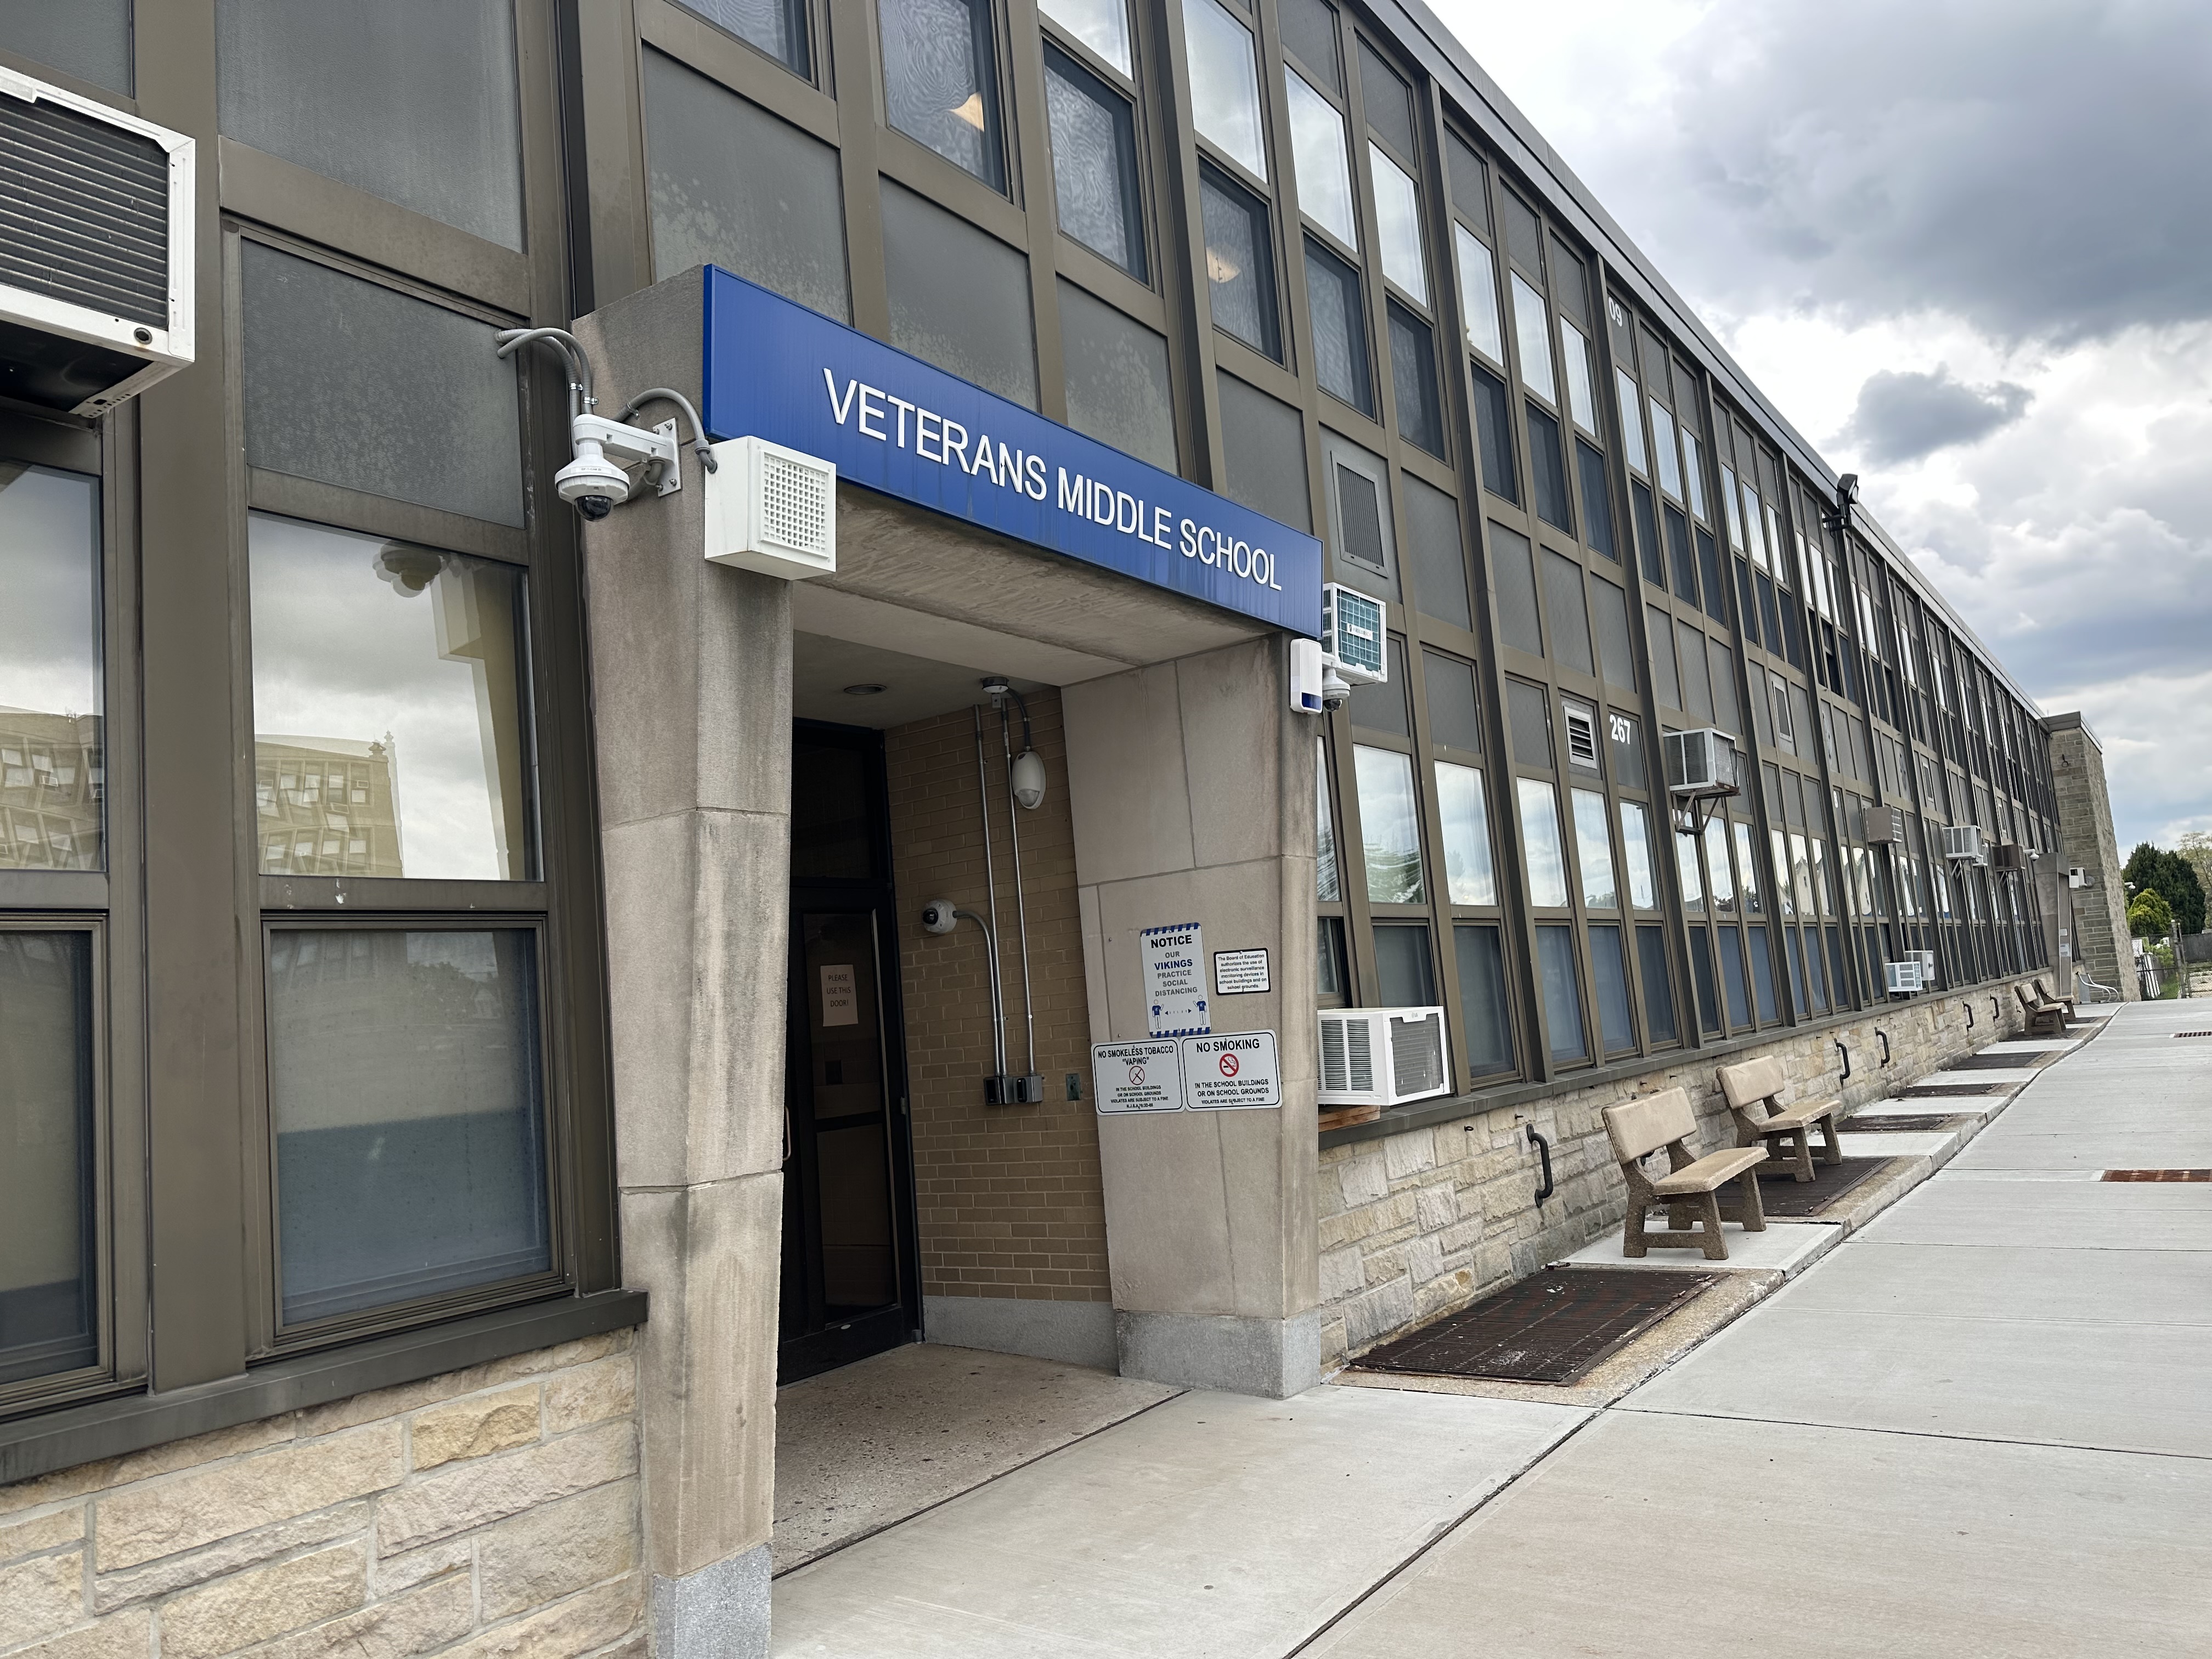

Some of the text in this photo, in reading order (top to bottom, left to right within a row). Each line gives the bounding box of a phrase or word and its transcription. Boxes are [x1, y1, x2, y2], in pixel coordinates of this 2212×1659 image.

[1609, 297, 1622, 326] 09
[823, 368, 1281, 591] VETERANS MIDDLE SCHOOL
[1610, 714, 1630, 744] 267
[1150, 934, 1192, 948] NOTICE
[1154, 959, 1193, 970] VIKINGS
[1157, 969, 1192, 979] PRACTICE
[1163, 979, 1188, 987] SOCIAL
[1155, 986, 1198, 997] DISTANCING
[1108, 1048, 1143, 1058] SMOKELESS
[1144, 1046, 1173, 1055] TOBACCO
[1196, 1039, 1260, 1053] NO SMOKING
